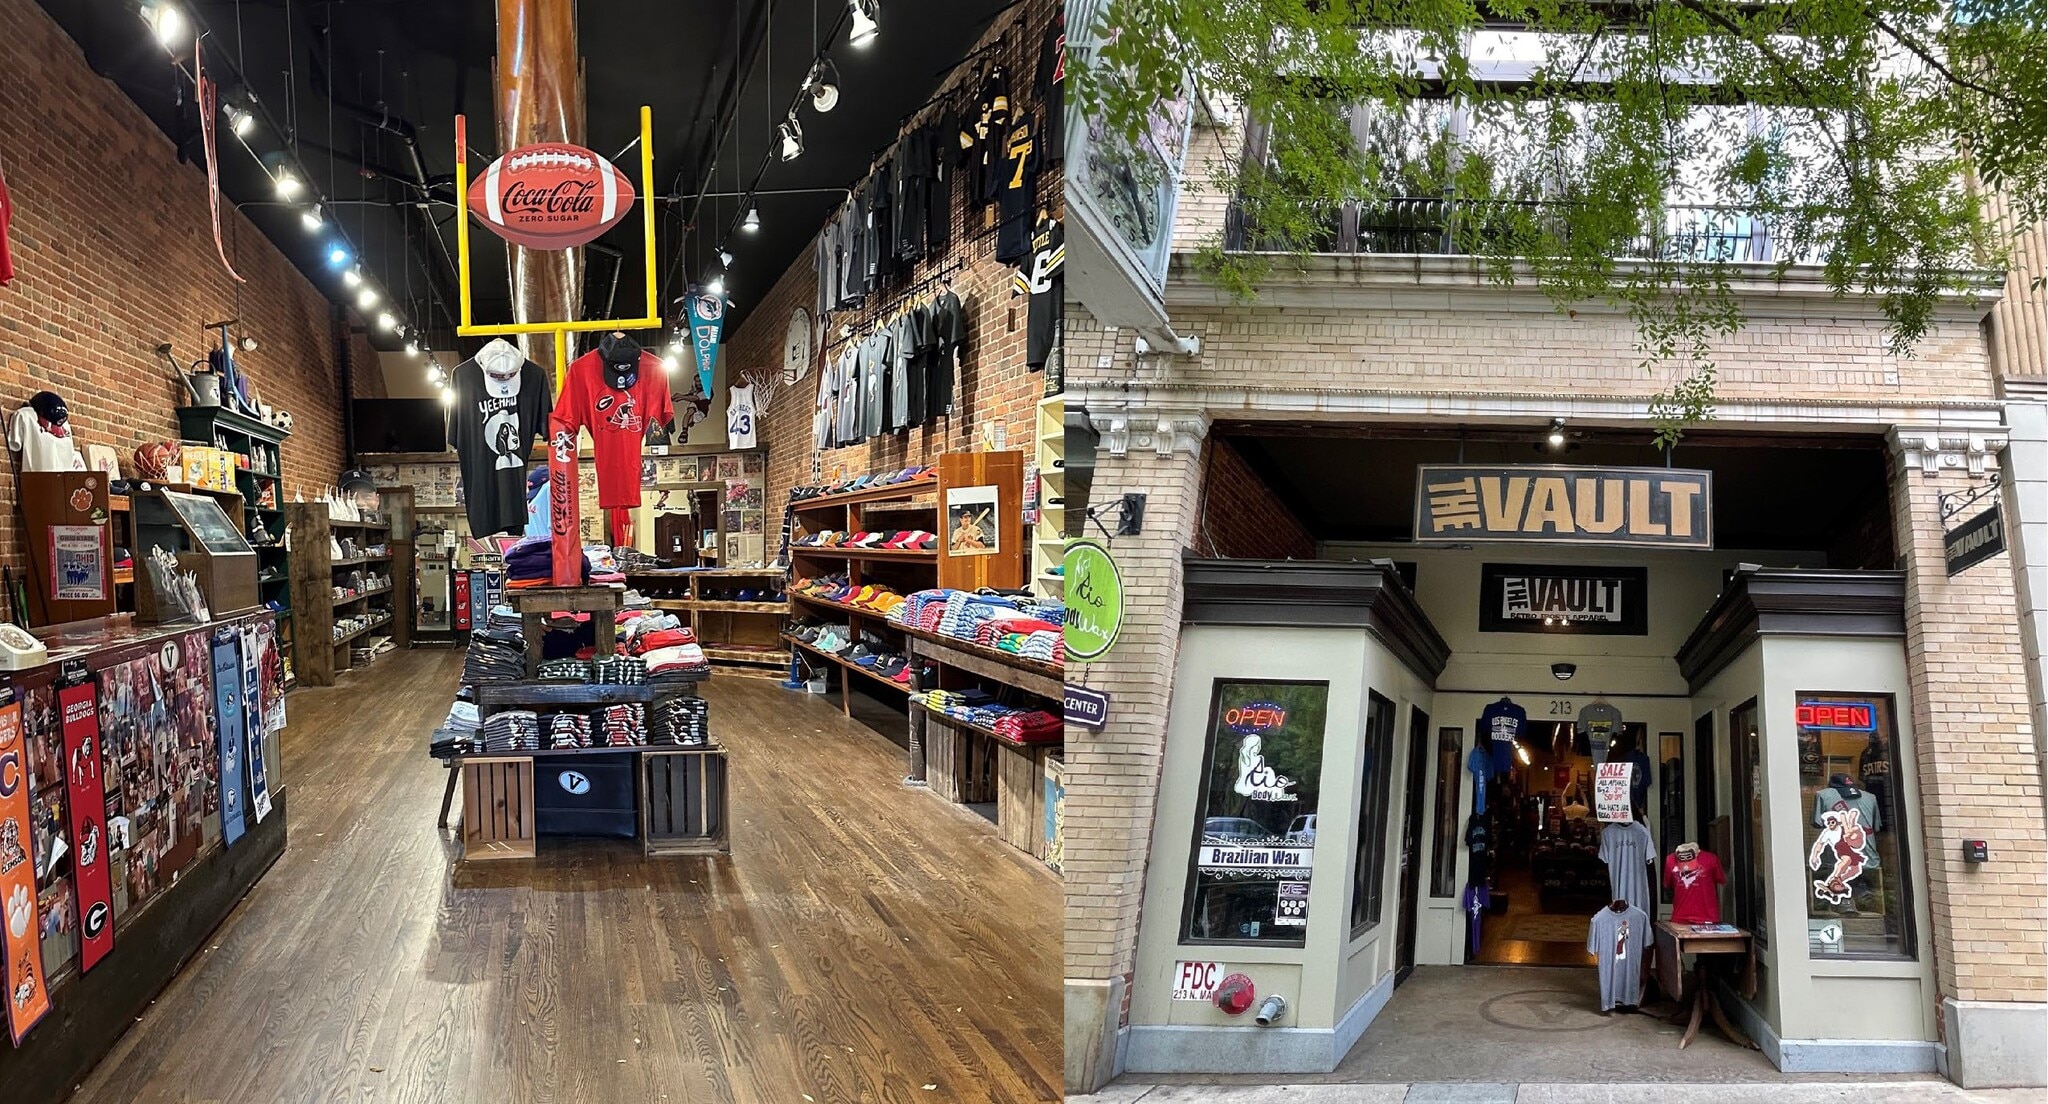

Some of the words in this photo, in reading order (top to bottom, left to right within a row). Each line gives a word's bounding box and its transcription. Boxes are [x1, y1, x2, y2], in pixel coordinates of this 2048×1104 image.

[1009, 139, 1032, 189] 7
[502, 180, 600, 215] Coca-Cola
[547, 214, 579, 222] SUGAR
[729, 414, 751, 435] 43
[551, 470, 567, 536] Coca-Cola
[1428, 477, 1481, 532] THE
[1479, 476, 1701, 537] VAULT
[1955, 518, 1998, 557] VAULT
[1506, 579, 1528, 611] THE
[1528, 578, 1619, 613] VAULT
[1064, 606, 1080, 629] ody
[1510, 612, 1537, 620] RETRO
[165, 646, 174, 668] V
[65, 700, 92, 714] GEORGIA
[1064, 697, 1098, 715] CENTER
[1550, 701, 1572, 714] 213
[65, 708, 94, 724] BULLDOGS
[1225, 708, 1286, 727] OPEN
[1796, 706, 1870, 726] OPEN
[1600, 763, 1626, 777] SALE
[568, 773, 583, 791] V
[1252, 790, 1272, 802] Body
[1212, 849, 1269, 864] Brazilian
[1272, 850, 1300, 865] Wax
[1824, 928, 1835, 941] V
[1181, 962, 1216, 990] FDC
[1173, 990, 1187, 999] 213
[1200, 990, 1214, 999] MA
